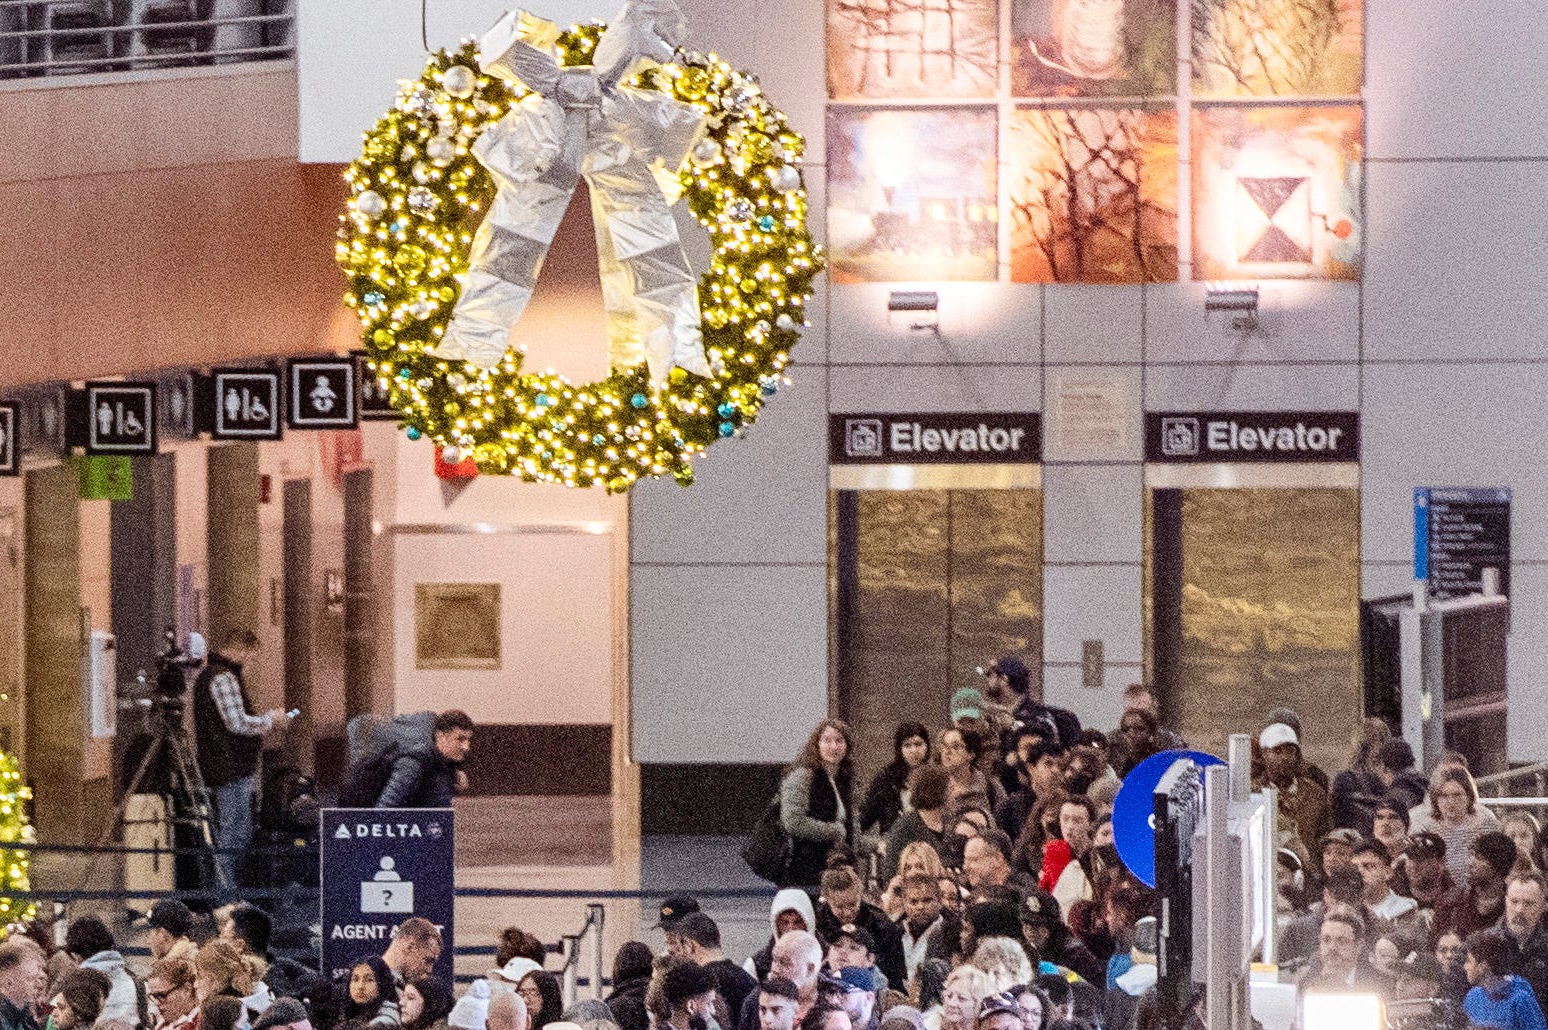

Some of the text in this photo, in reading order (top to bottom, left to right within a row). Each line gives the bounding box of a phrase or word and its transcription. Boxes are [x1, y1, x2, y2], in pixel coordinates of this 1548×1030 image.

[890, 422, 1025, 452] Elevator
[1207, 421, 1341, 451] Elevator
[356, 823, 422, 838] DELTA
[332, 924, 388, 940] AGENT
